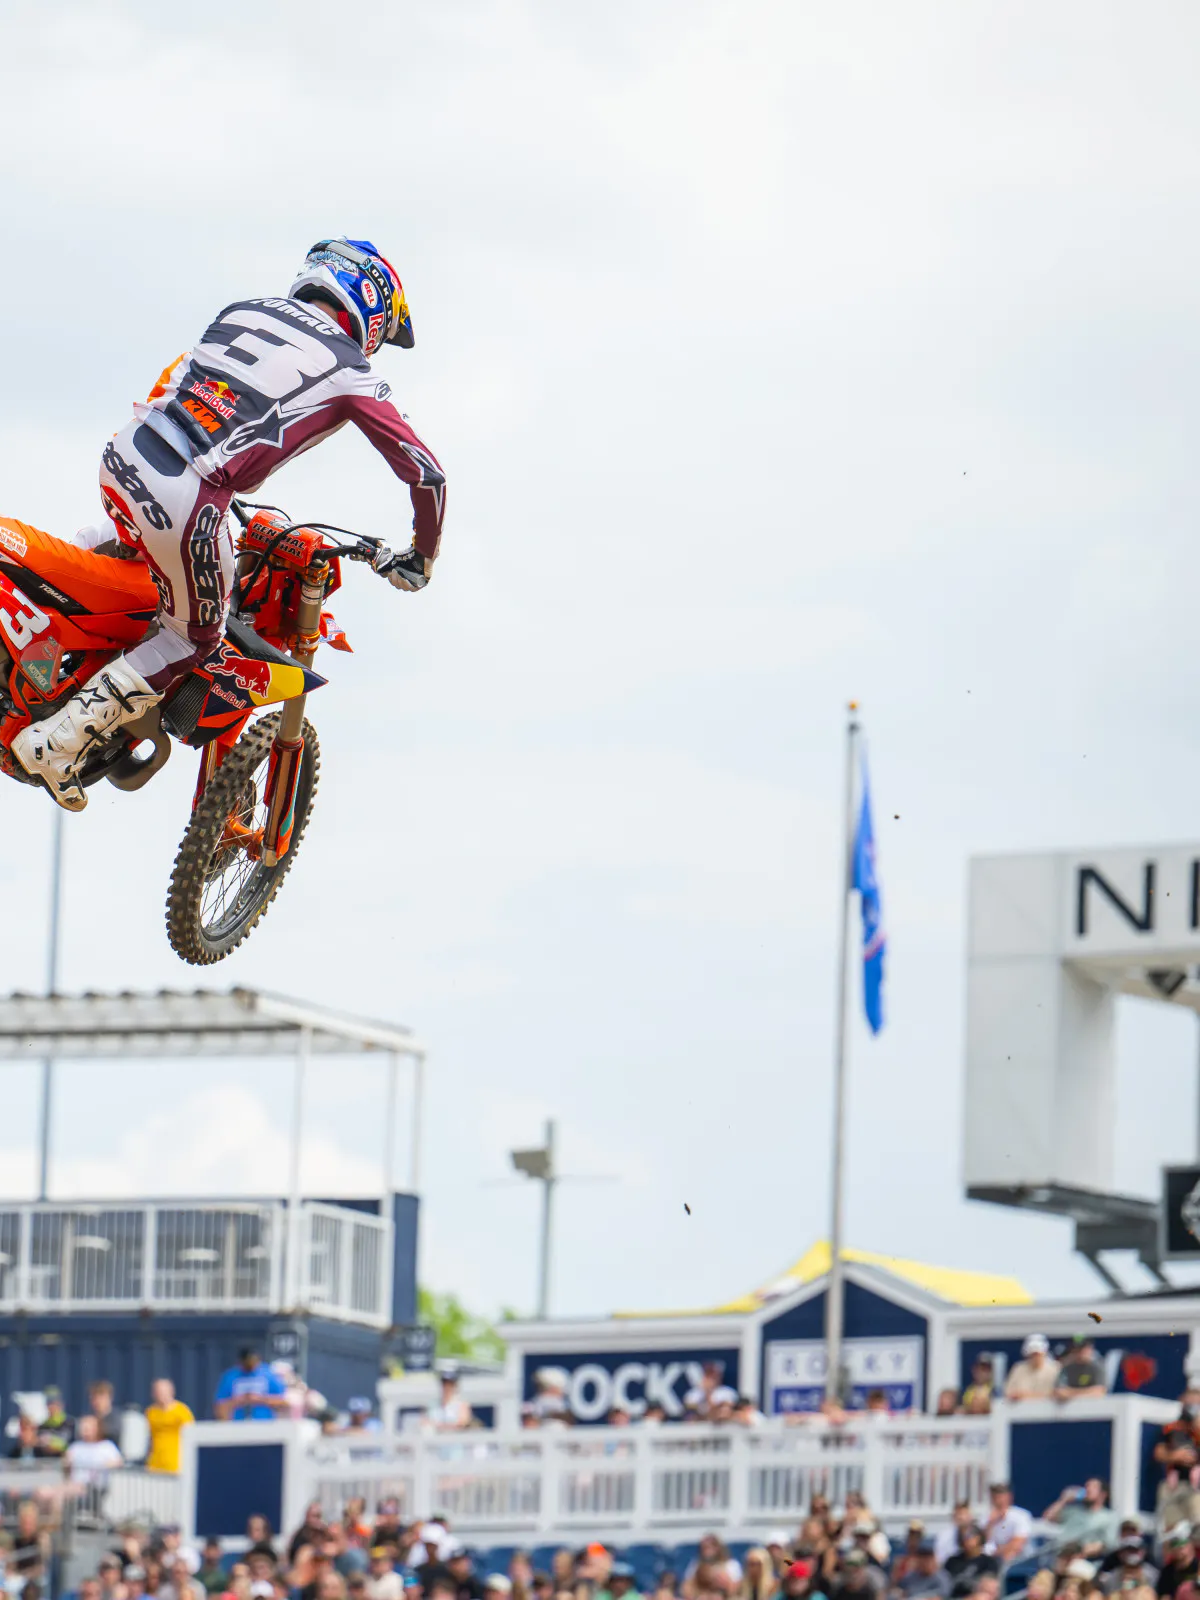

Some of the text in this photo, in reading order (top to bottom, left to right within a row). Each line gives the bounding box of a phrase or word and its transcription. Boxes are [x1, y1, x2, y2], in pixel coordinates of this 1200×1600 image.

[364, 283, 375, 304] BELL
[371, 268, 392, 329] OAKLEY
[249, 299, 340, 336] TOMAC
[194, 309, 338, 399] 3
[182, 398, 222, 434] KTM
[249, 531, 303, 559] RENHAL
[252, 523, 306, 551] RENHAL
[38, 583, 69, 604] TOMAC
[27, 662, 49, 688] MOTOREX
[538, 1361, 726, 1421] OCKY
